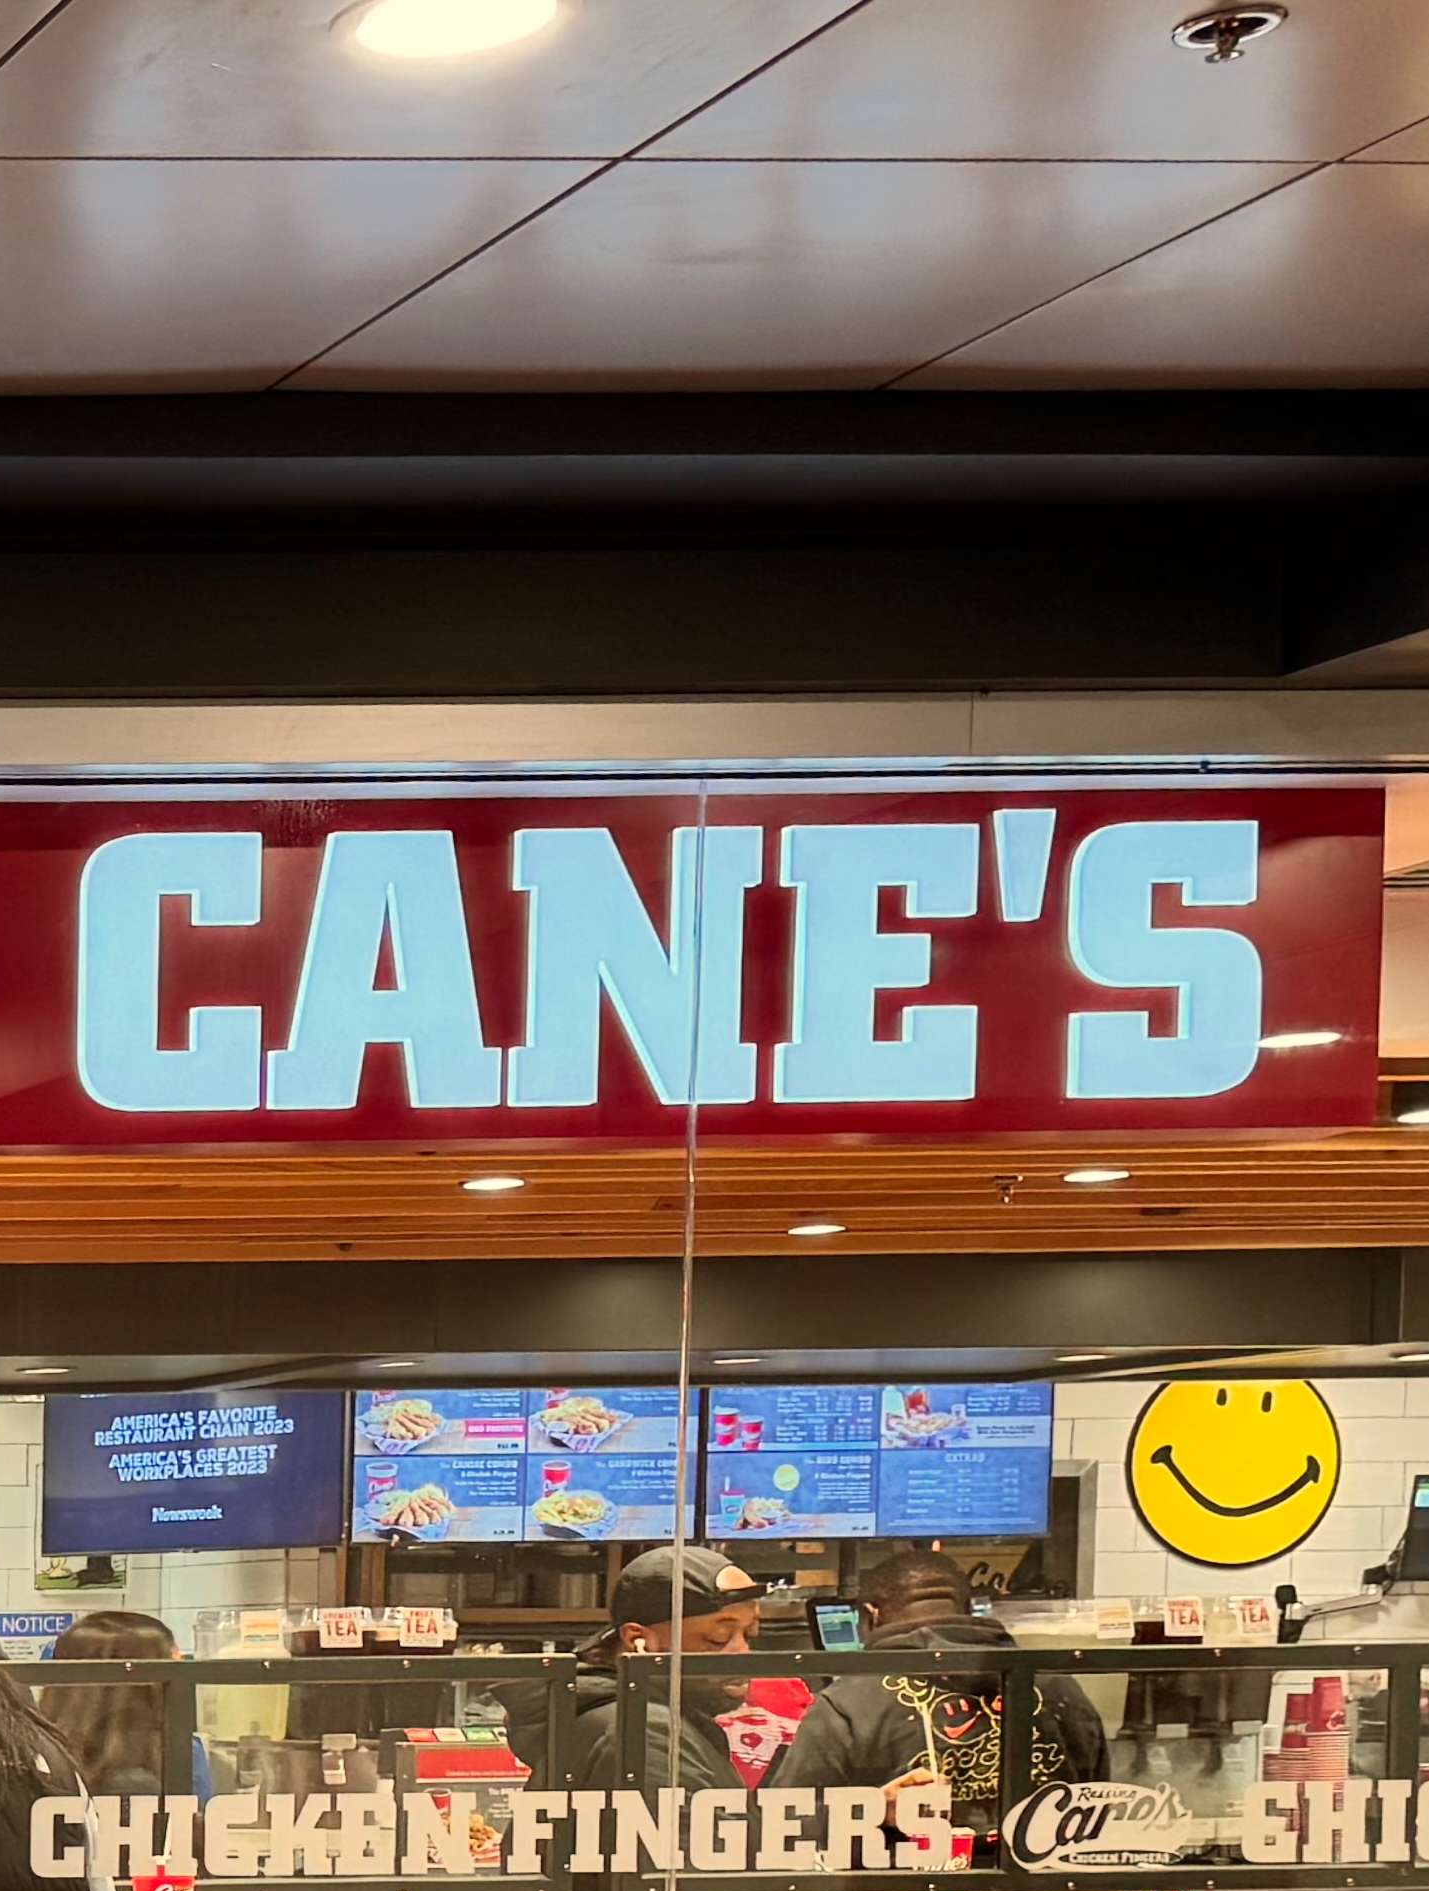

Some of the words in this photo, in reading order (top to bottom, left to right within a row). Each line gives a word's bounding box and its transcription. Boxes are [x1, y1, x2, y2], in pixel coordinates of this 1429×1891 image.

[74, 806, 1263, 1114] CANE'S
[111, 1410, 194, 1432] AMERICA'S
[198, 1406, 278, 1425] FAVORITE
[94, 1425, 197, 1446] RESTAURANT
[200, 1422, 250, 1439] CHAIN
[254, 1419, 294, 1435] 2023
[109, 1450, 192, 1469] AMERICA'S
[196, 1444, 278, 1463] GREATEST
[117, 1462, 224, 1482] WORKPLACES
[227, 1460, 268, 1475] 2023
[152, 1504, 223, 1522] Newsweek
[1, 1615, 66, 1633] NOTICE
[1168, 1608, 1200, 1625] TEA
[1239, 1606, 1271, 1623] TEA
[325, 1620, 358, 1636] TEA
[405, 1618, 439, 1634] TEA
[29, 1792, 478, 1878] CHICKEN
[506, 1784, 953, 1875] FINGERS
